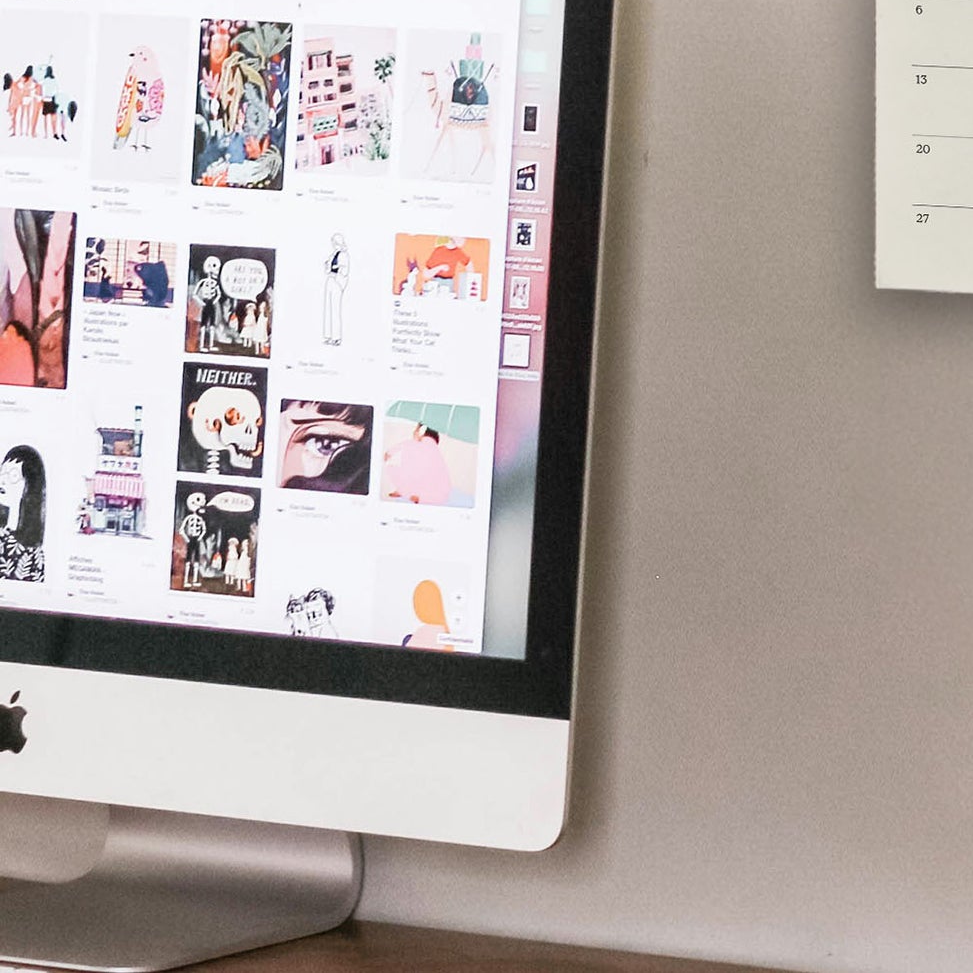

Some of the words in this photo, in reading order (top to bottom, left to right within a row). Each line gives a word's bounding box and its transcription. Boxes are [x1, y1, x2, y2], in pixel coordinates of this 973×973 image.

[915, 4, 924, 16] 6
[915, 74, 928, 85] 13
[915, 143, 931, 155] 20
[915, 212, 930, 224] 27
[196, 368, 257, 386] NEITHER.
